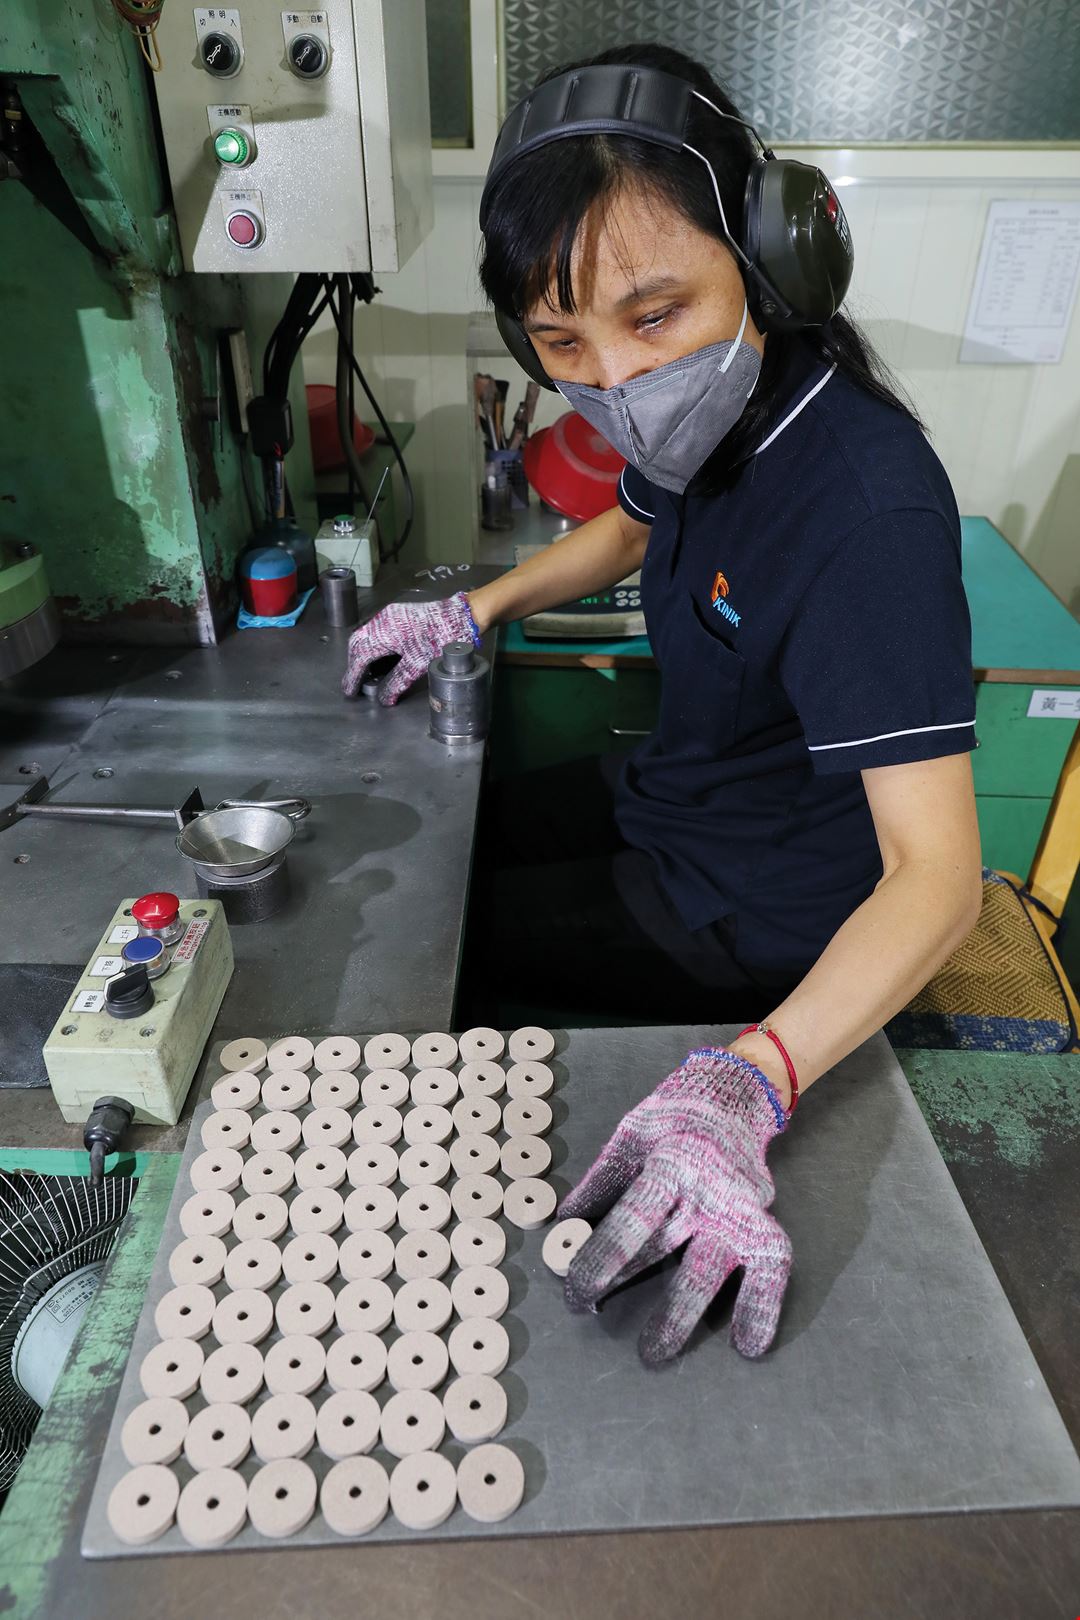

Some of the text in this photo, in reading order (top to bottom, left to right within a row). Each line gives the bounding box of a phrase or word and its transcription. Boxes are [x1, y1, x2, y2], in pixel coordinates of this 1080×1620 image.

[286, 14, 299, 23] 手動
[310, 14, 323, 23] 自動
[712, 596, 742, 628] KINIK
